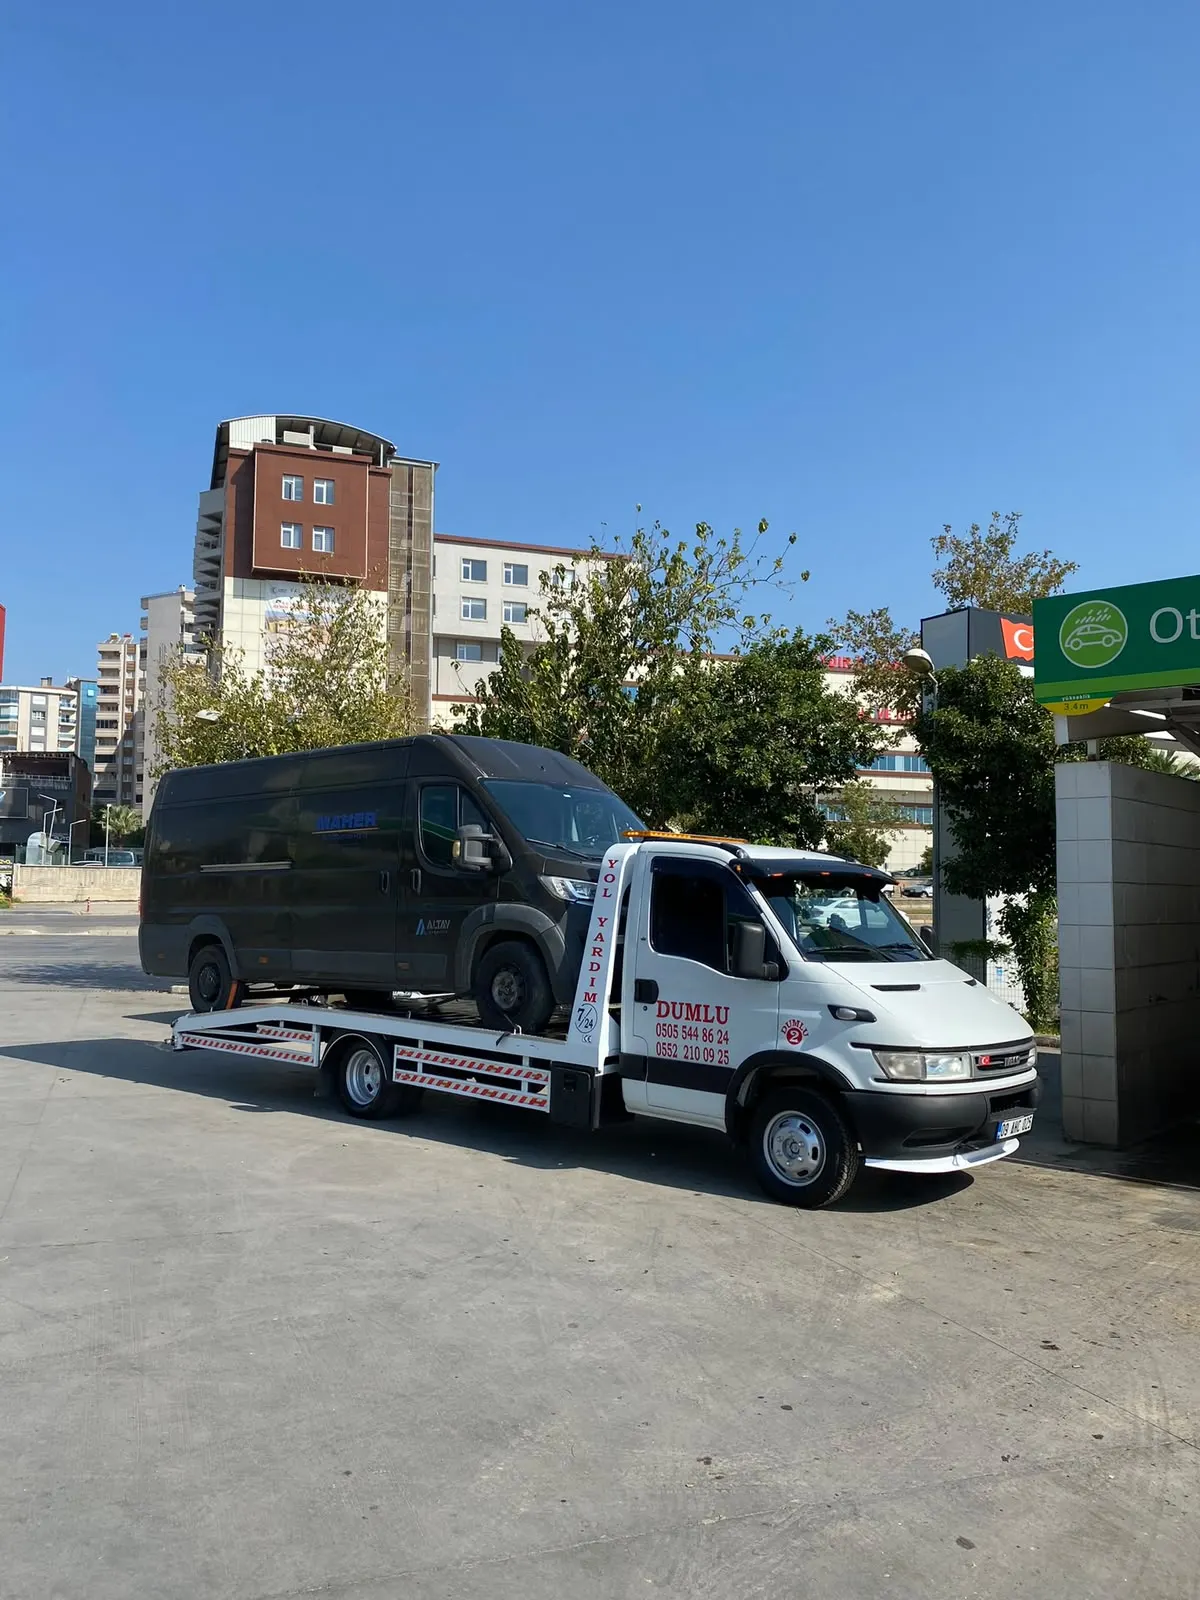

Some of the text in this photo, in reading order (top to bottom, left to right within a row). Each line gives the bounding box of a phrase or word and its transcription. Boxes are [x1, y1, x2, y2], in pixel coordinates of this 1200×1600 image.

[583, 859, 619, 1003] YOL YARDIM
[577, 1007, 594, 1029] 7/24
[656, 1000, 730, 1025] DUMLU
[655, 1022, 729, 1045] 0505 544 86 24
[780, 1019, 809, 1037] DUMLU
[789, 1030, 800, 1043] 2
[656, 1041, 730, 1065] 0552 210 09 25
